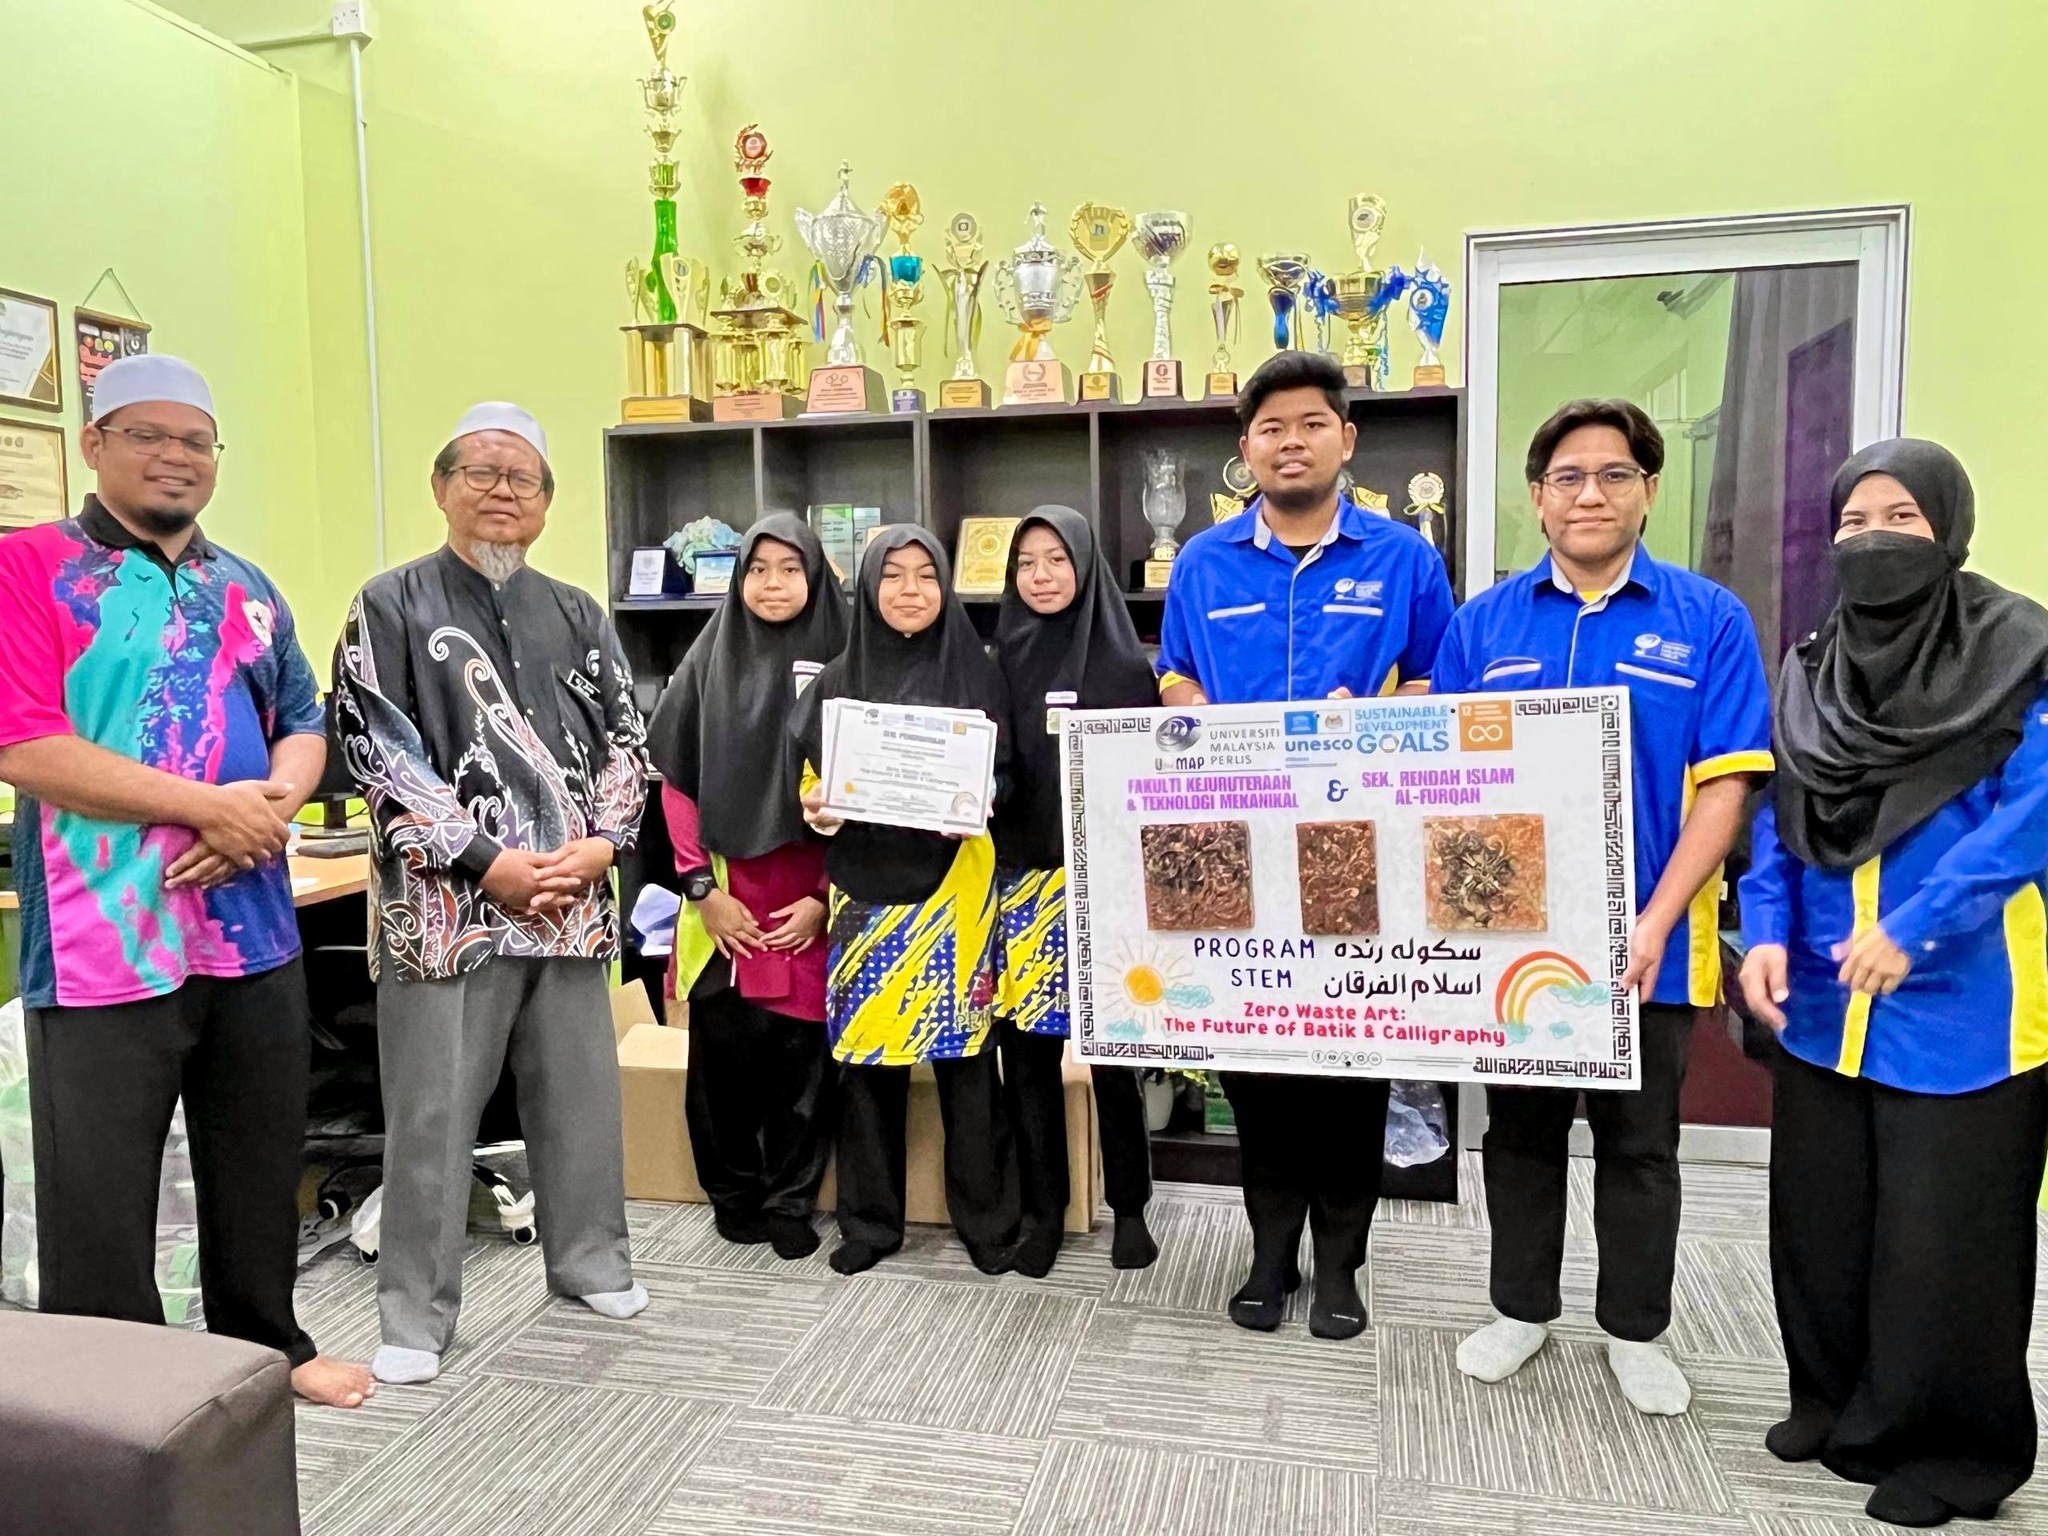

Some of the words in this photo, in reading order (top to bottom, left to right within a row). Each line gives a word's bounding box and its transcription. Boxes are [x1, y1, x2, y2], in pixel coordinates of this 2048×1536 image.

[1355, 705, 1448, 719] SUSTAINABLE
[1210, 729, 1280, 740] UNIVERSITI
[1356, 719, 1447, 732] DEVELOPMENT
[1210, 741, 1275, 752] MALAYSIA
[1285, 738, 1353, 752] unesco
[1356, 731, 1450, 755] GOALS
[1211, 755, 1252, 765] PERLIS
[1128, 778, 1181, 793] FAKULTI
[1186, 775, 1291, 793] KEJURUTERAAN
[1362, 772, 1393, 788] SEK.
[1400, 769, 1460, 786] RENDAH
[1466, 768, 1514, 785] ISLAM
[1327, 779, 1348, 803] &
[1396, 788, 1481, 806] AL-FURQAN
[1142, 795, 1215, 810] TEKNOLOGI
[1220, 792, 1299, 809] MEKANIKAL
[1194, 937, 1315, 958] PROGRAM
[1334, 938, 1383, 964] رنده
[1391, 937, 1481, 965] سكوله
[1231, 969, 1292, 988] STEM
[1324, 970, 1406, 999] الفرقان
[1411, 972, 1481, 1003] اسلام
[1244, 1002, 1289, 1017] Zero
[1296, 1004, 1357, 1020] Waste
[1364, 1006, 1406, 1021] Art:
[1164, 1018, 1195, 1032] The
[1202, 1018, 1268, 1035] Future
[1276, 1021, 1296, 1036] of
[1304, 1022, 1356, 1038] Batik
[1365, 1023, 1375, 1038] &
[1383, 1024, 1506, 1047] Calligraphy
